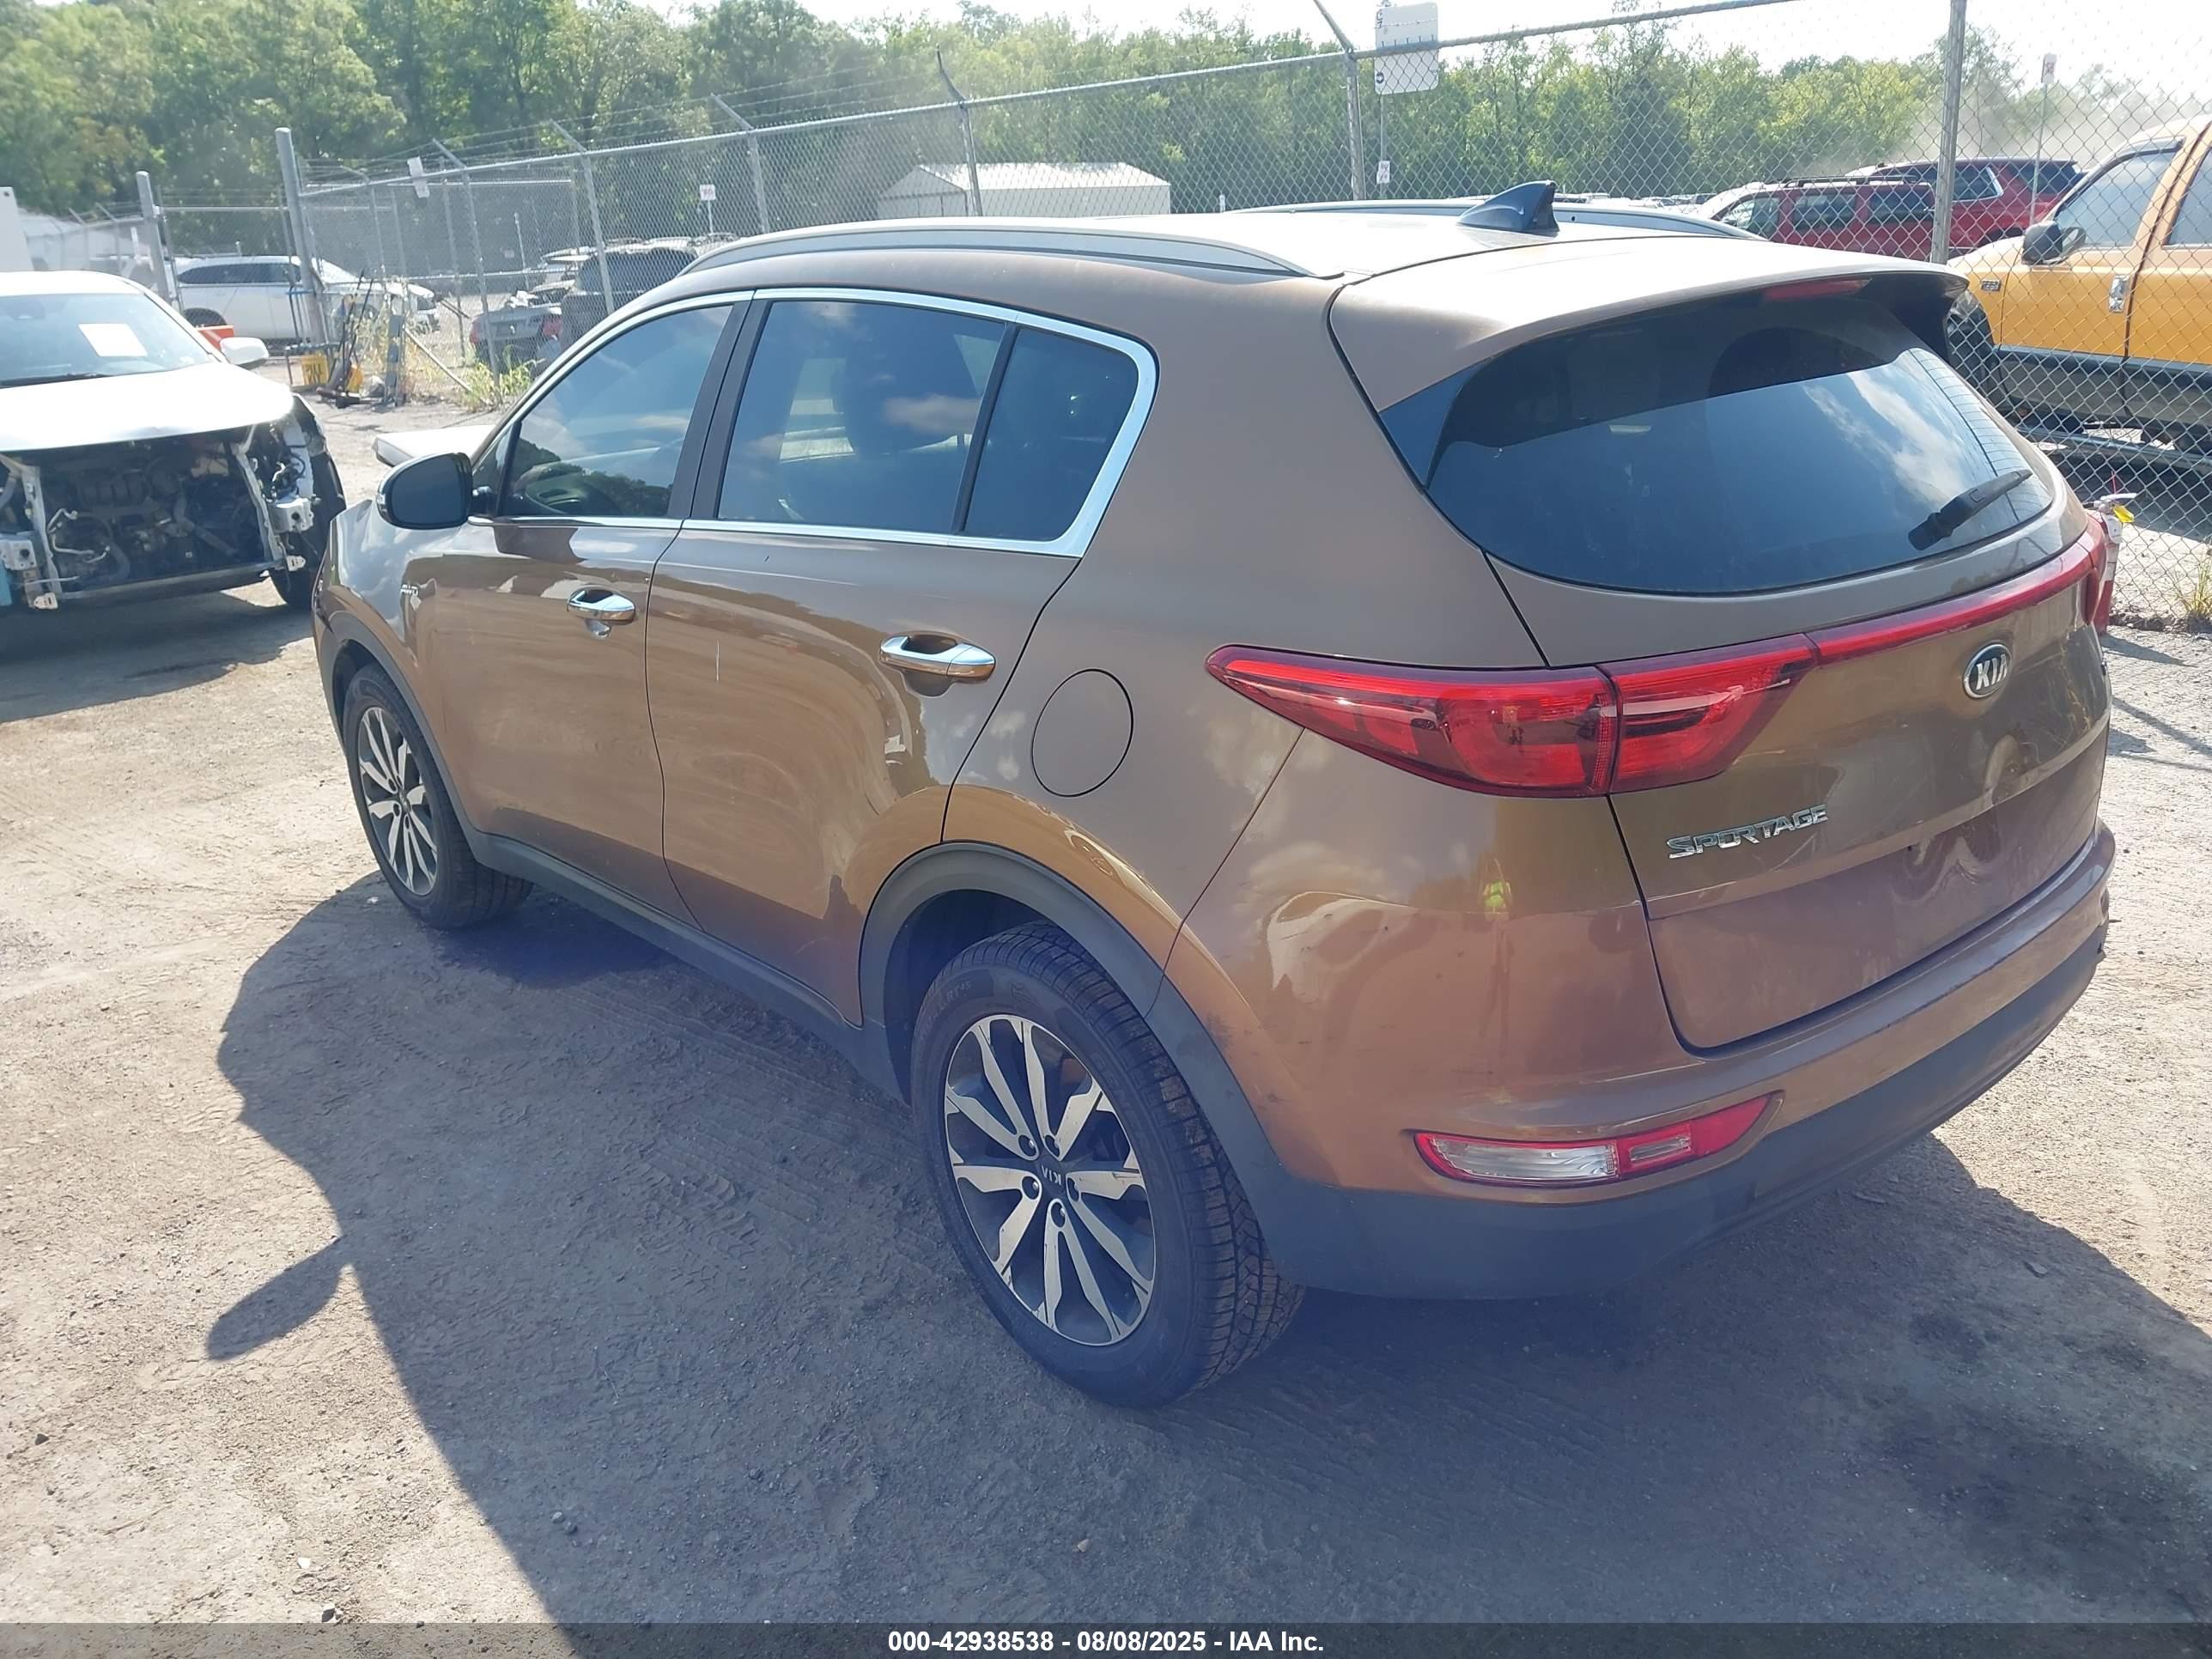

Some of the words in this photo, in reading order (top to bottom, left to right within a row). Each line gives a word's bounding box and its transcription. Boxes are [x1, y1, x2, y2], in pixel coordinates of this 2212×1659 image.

[1976, 653, 2008, 690] KIA
[1667, 804, 1828, 859] SPORTAGE
[1041, 1164, 1062, 1186] KIA
